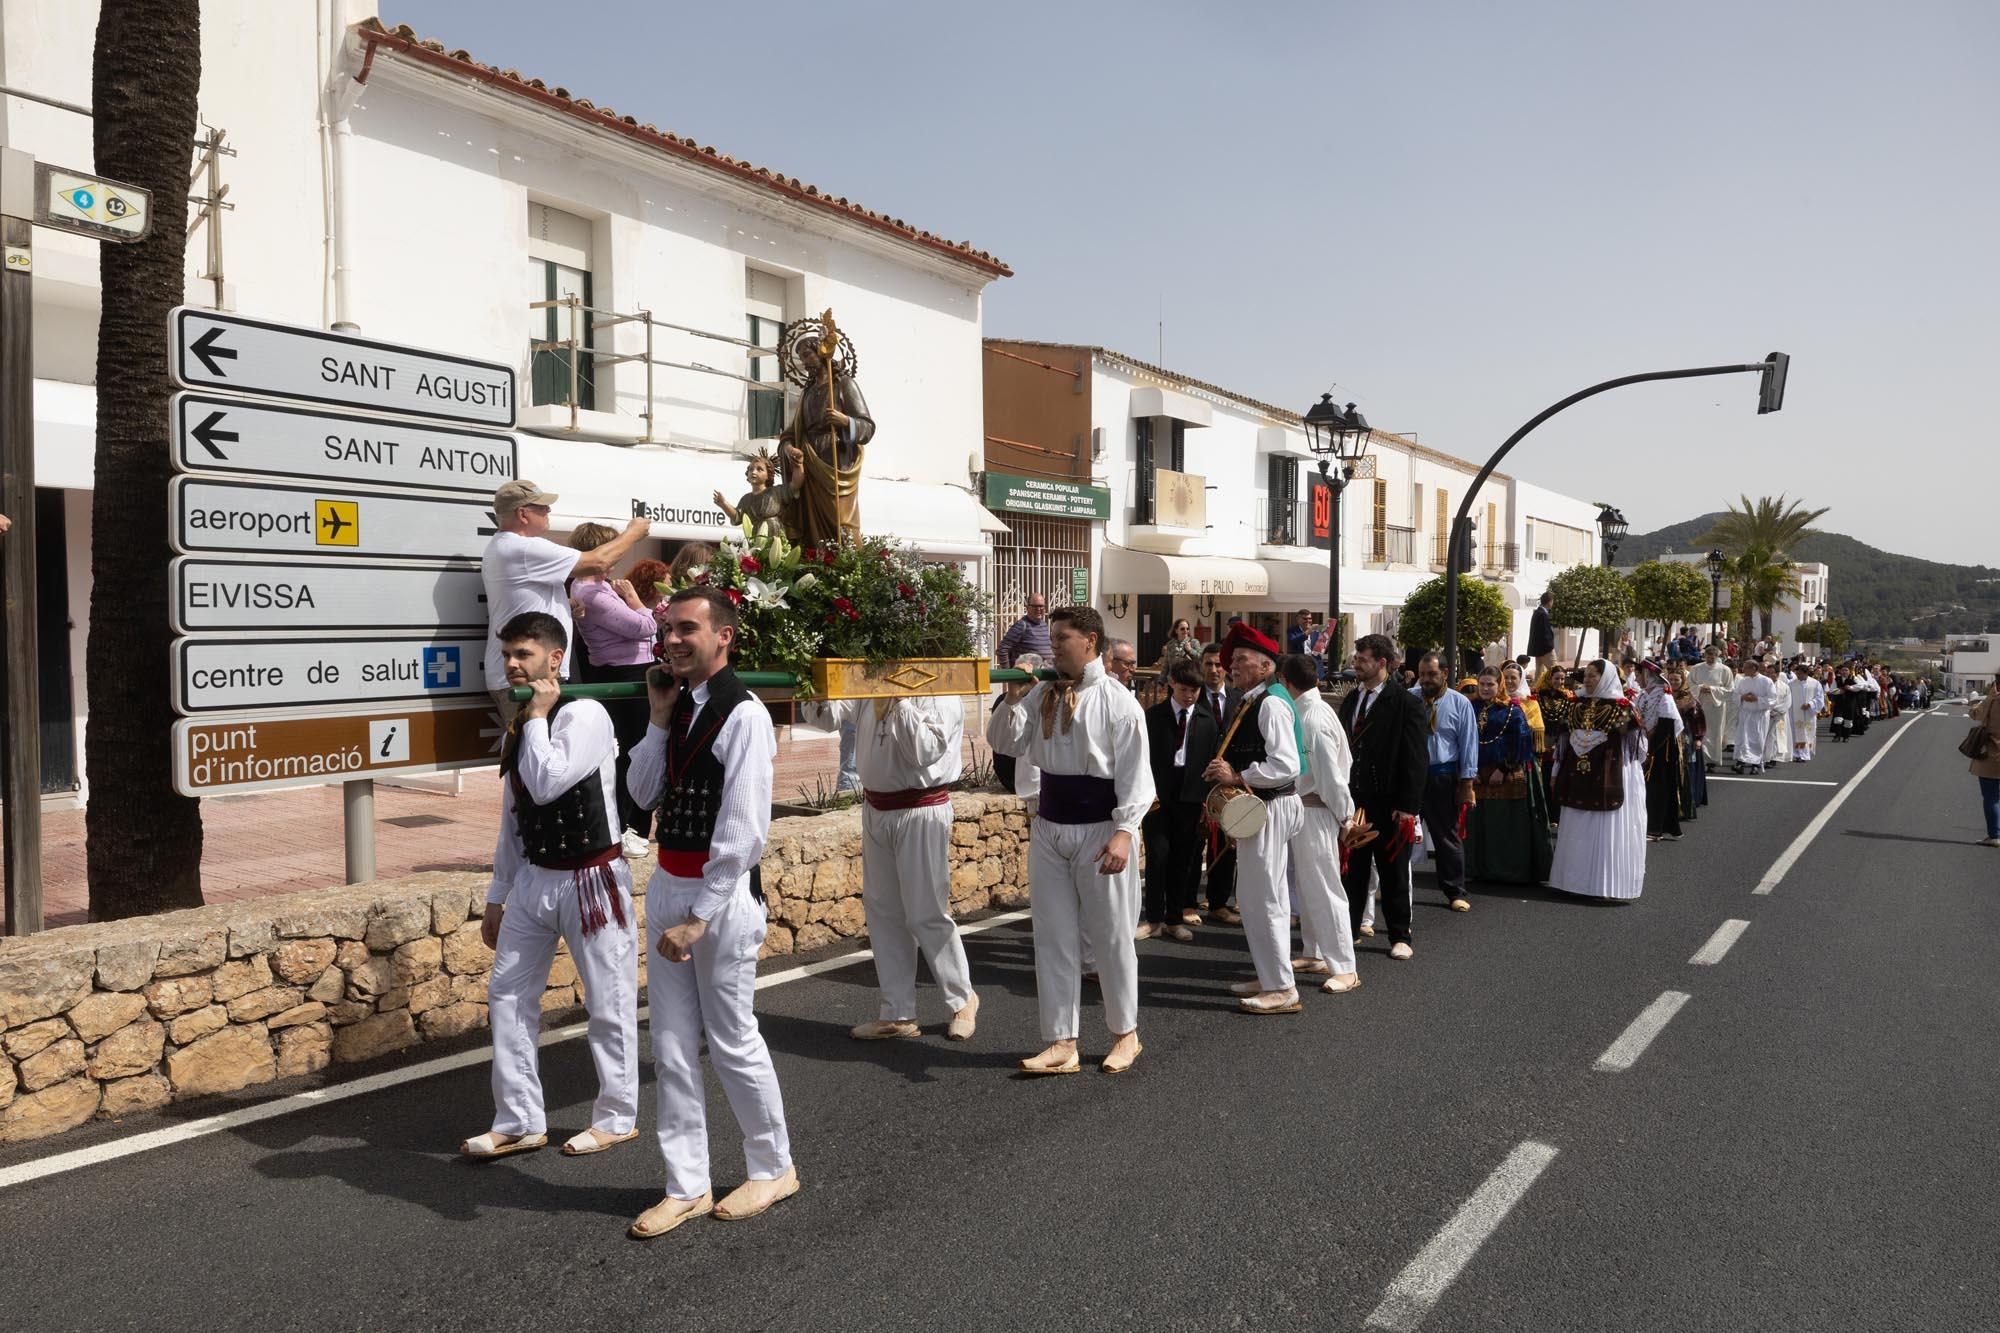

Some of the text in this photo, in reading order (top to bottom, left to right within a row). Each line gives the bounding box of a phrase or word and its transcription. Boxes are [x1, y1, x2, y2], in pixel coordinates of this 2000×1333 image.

[80, 193, 89, 206] 4
[109, 200, 125, 213] 12
[320, 356, 507, 408] SANT AGUSTÍ
[324, 435, 511, 477] SANT ANTONI
[1009, 488, 1093, 505] SPANISCHE KERAMIK POTTERY
[1055, 485, 1079, 493] POPULAR
[1006, 499, 1096, 515] ORIGINAL GLASKUNST LAMPARAS
[189, 508, 311, 538] aeroport
[189, 582, 315, 608] EIVISSA
[1201, 580, 1234, 593] EL PALIO
[192, 658, 420, 689] centre de salut
[192, 725, 257, 759] punt
